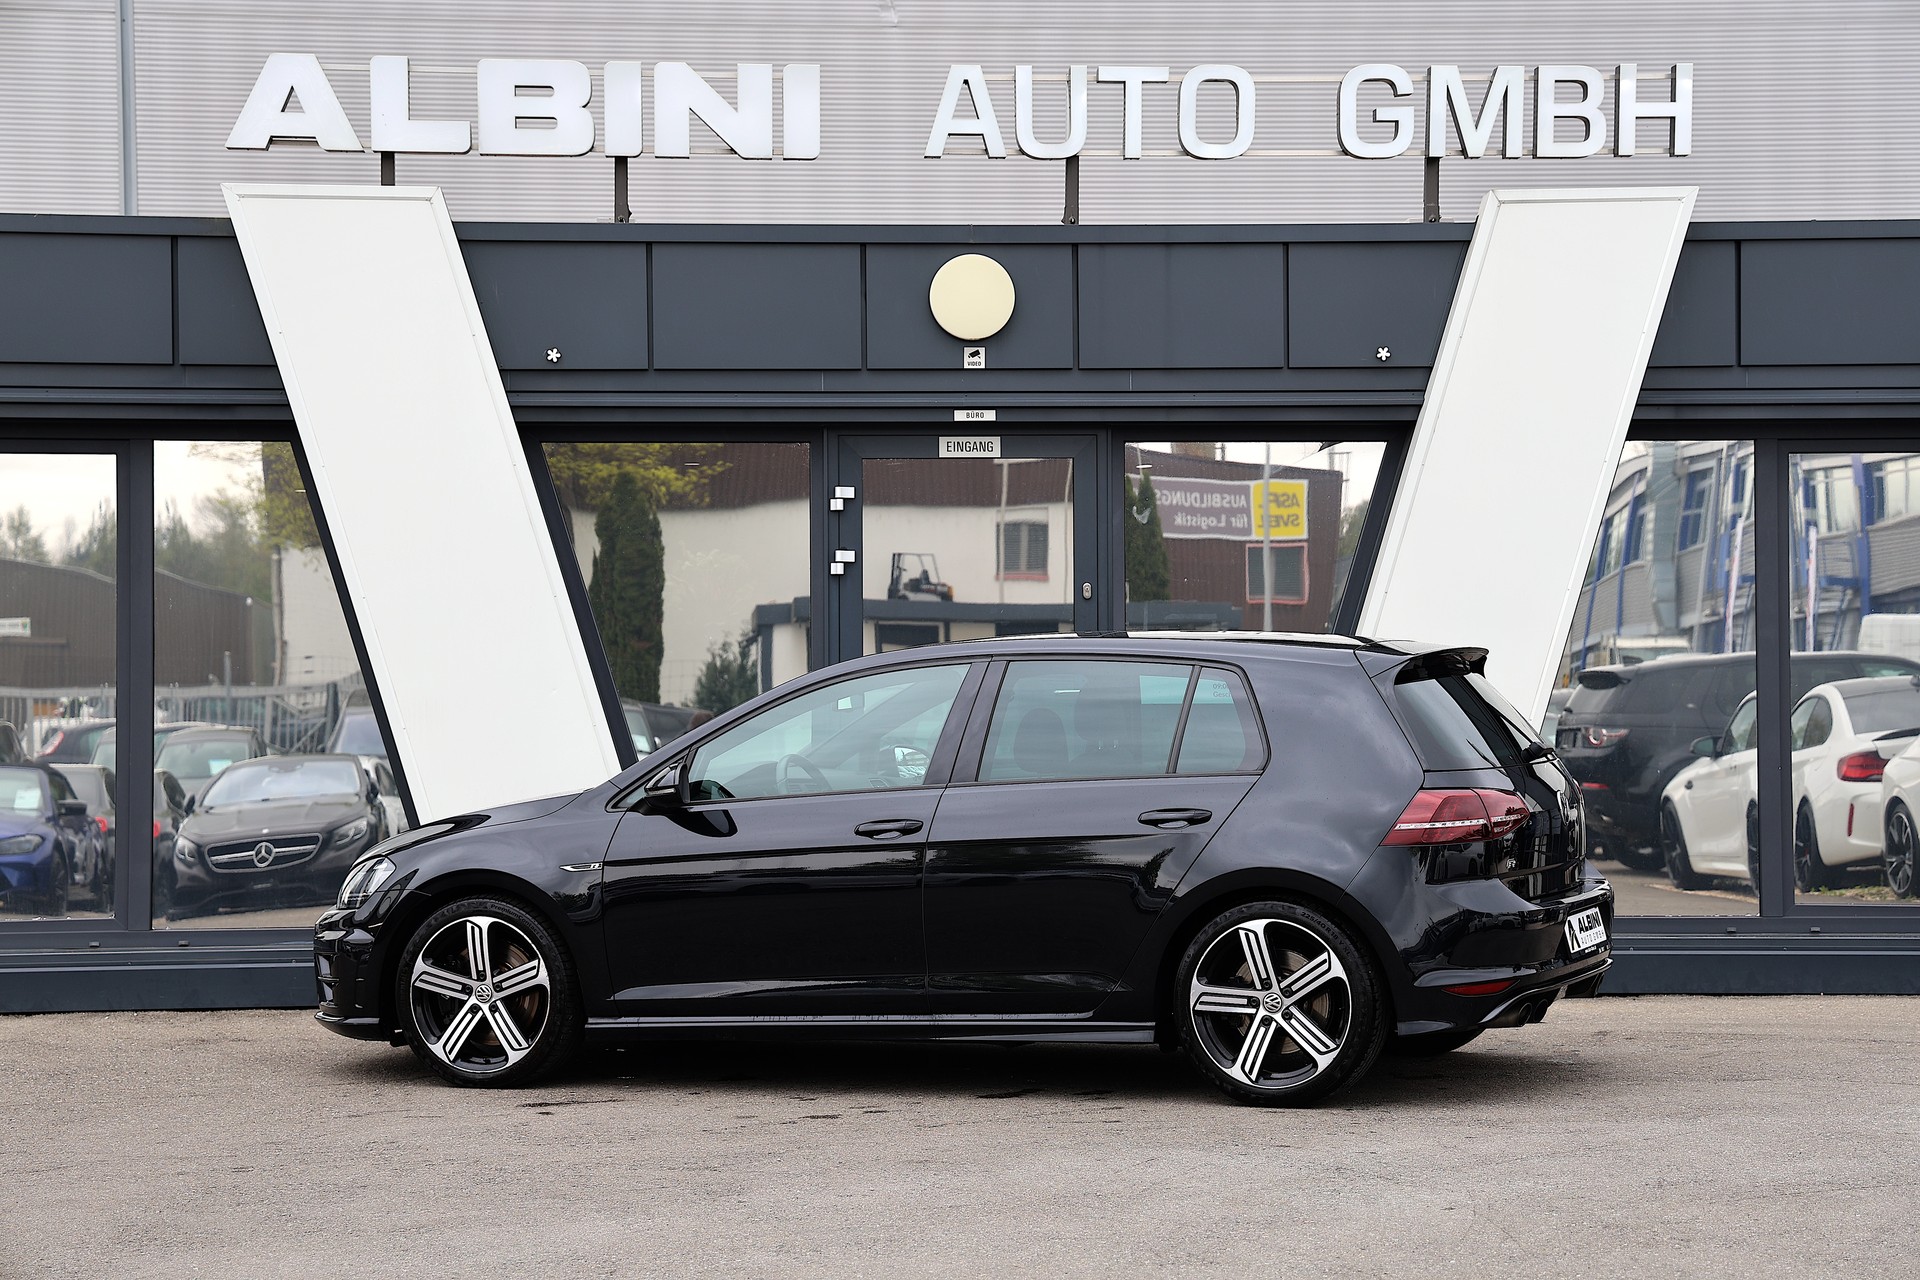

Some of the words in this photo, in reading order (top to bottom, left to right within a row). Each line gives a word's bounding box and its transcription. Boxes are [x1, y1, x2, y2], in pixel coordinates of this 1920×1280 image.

[225, 52, 821, 160] ALBINI
[924, 63, 1256, 160] AUTO
[1338, 62, 1694, 160] GMBH
[966, 411, 985, 419] BÜRO
[946, 441, 994, 453] EINGANG
